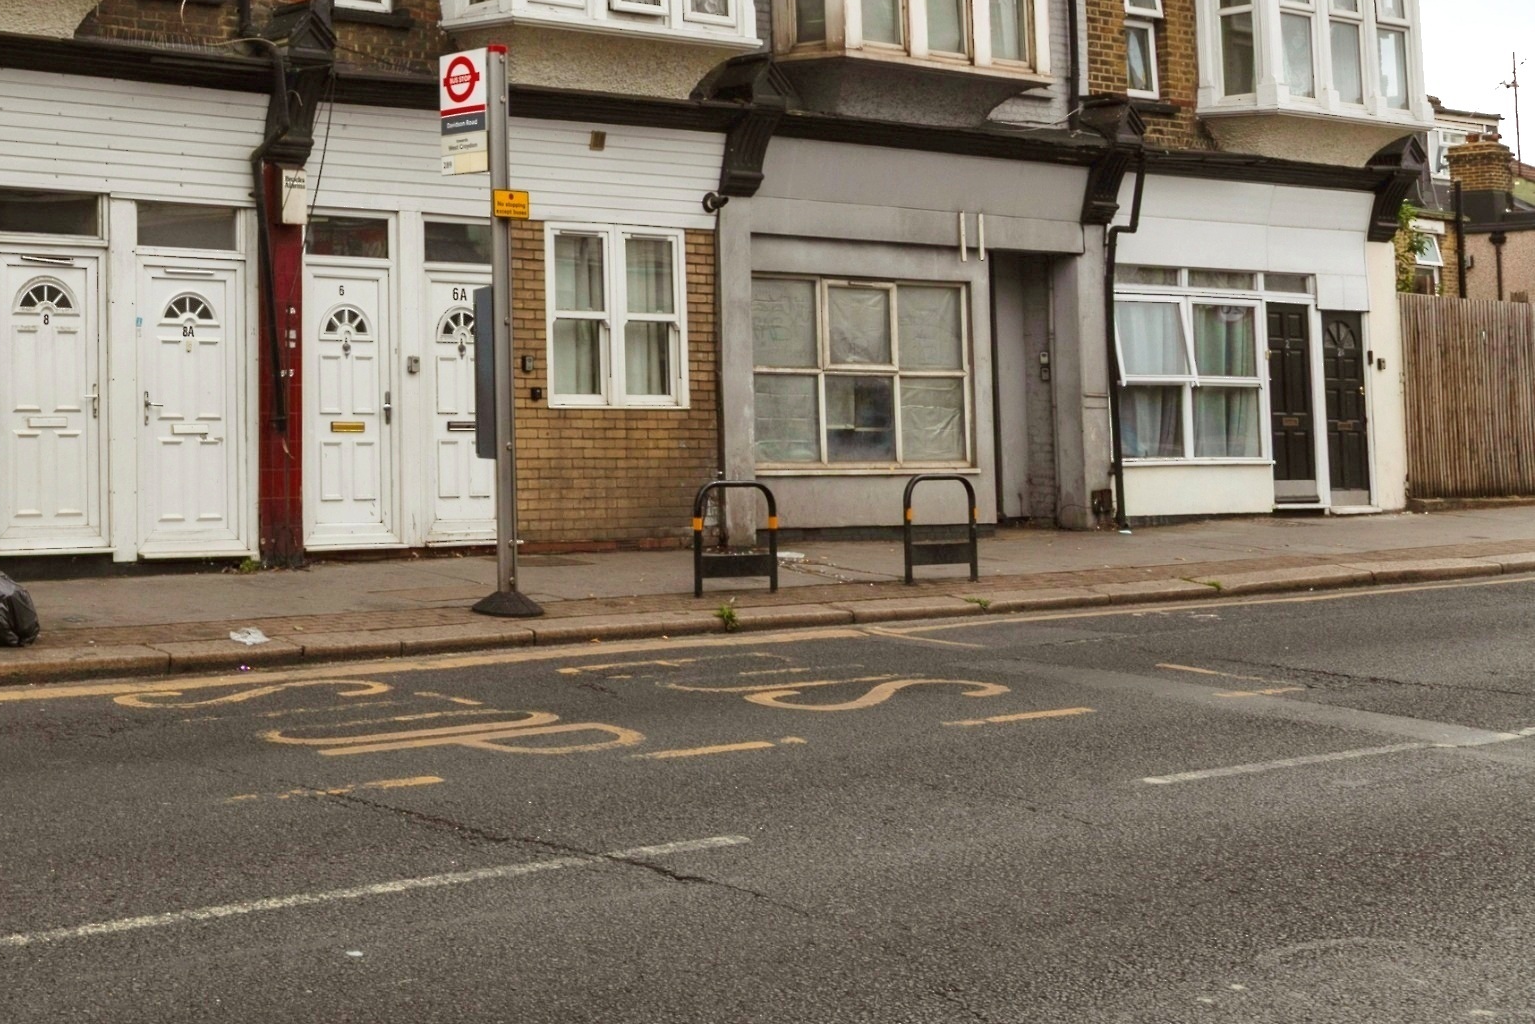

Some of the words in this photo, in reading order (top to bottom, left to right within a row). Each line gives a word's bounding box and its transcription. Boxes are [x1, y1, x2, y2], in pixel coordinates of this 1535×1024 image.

[449, 76, 459, 85] BUS
[459, 74, 472, 83] STOP
[339, 285, 345, 296] 6
[453, 288, 467, 301] 6A
[43, 314, 49, 325] 8
[182, 326, 195, 337] 8A
